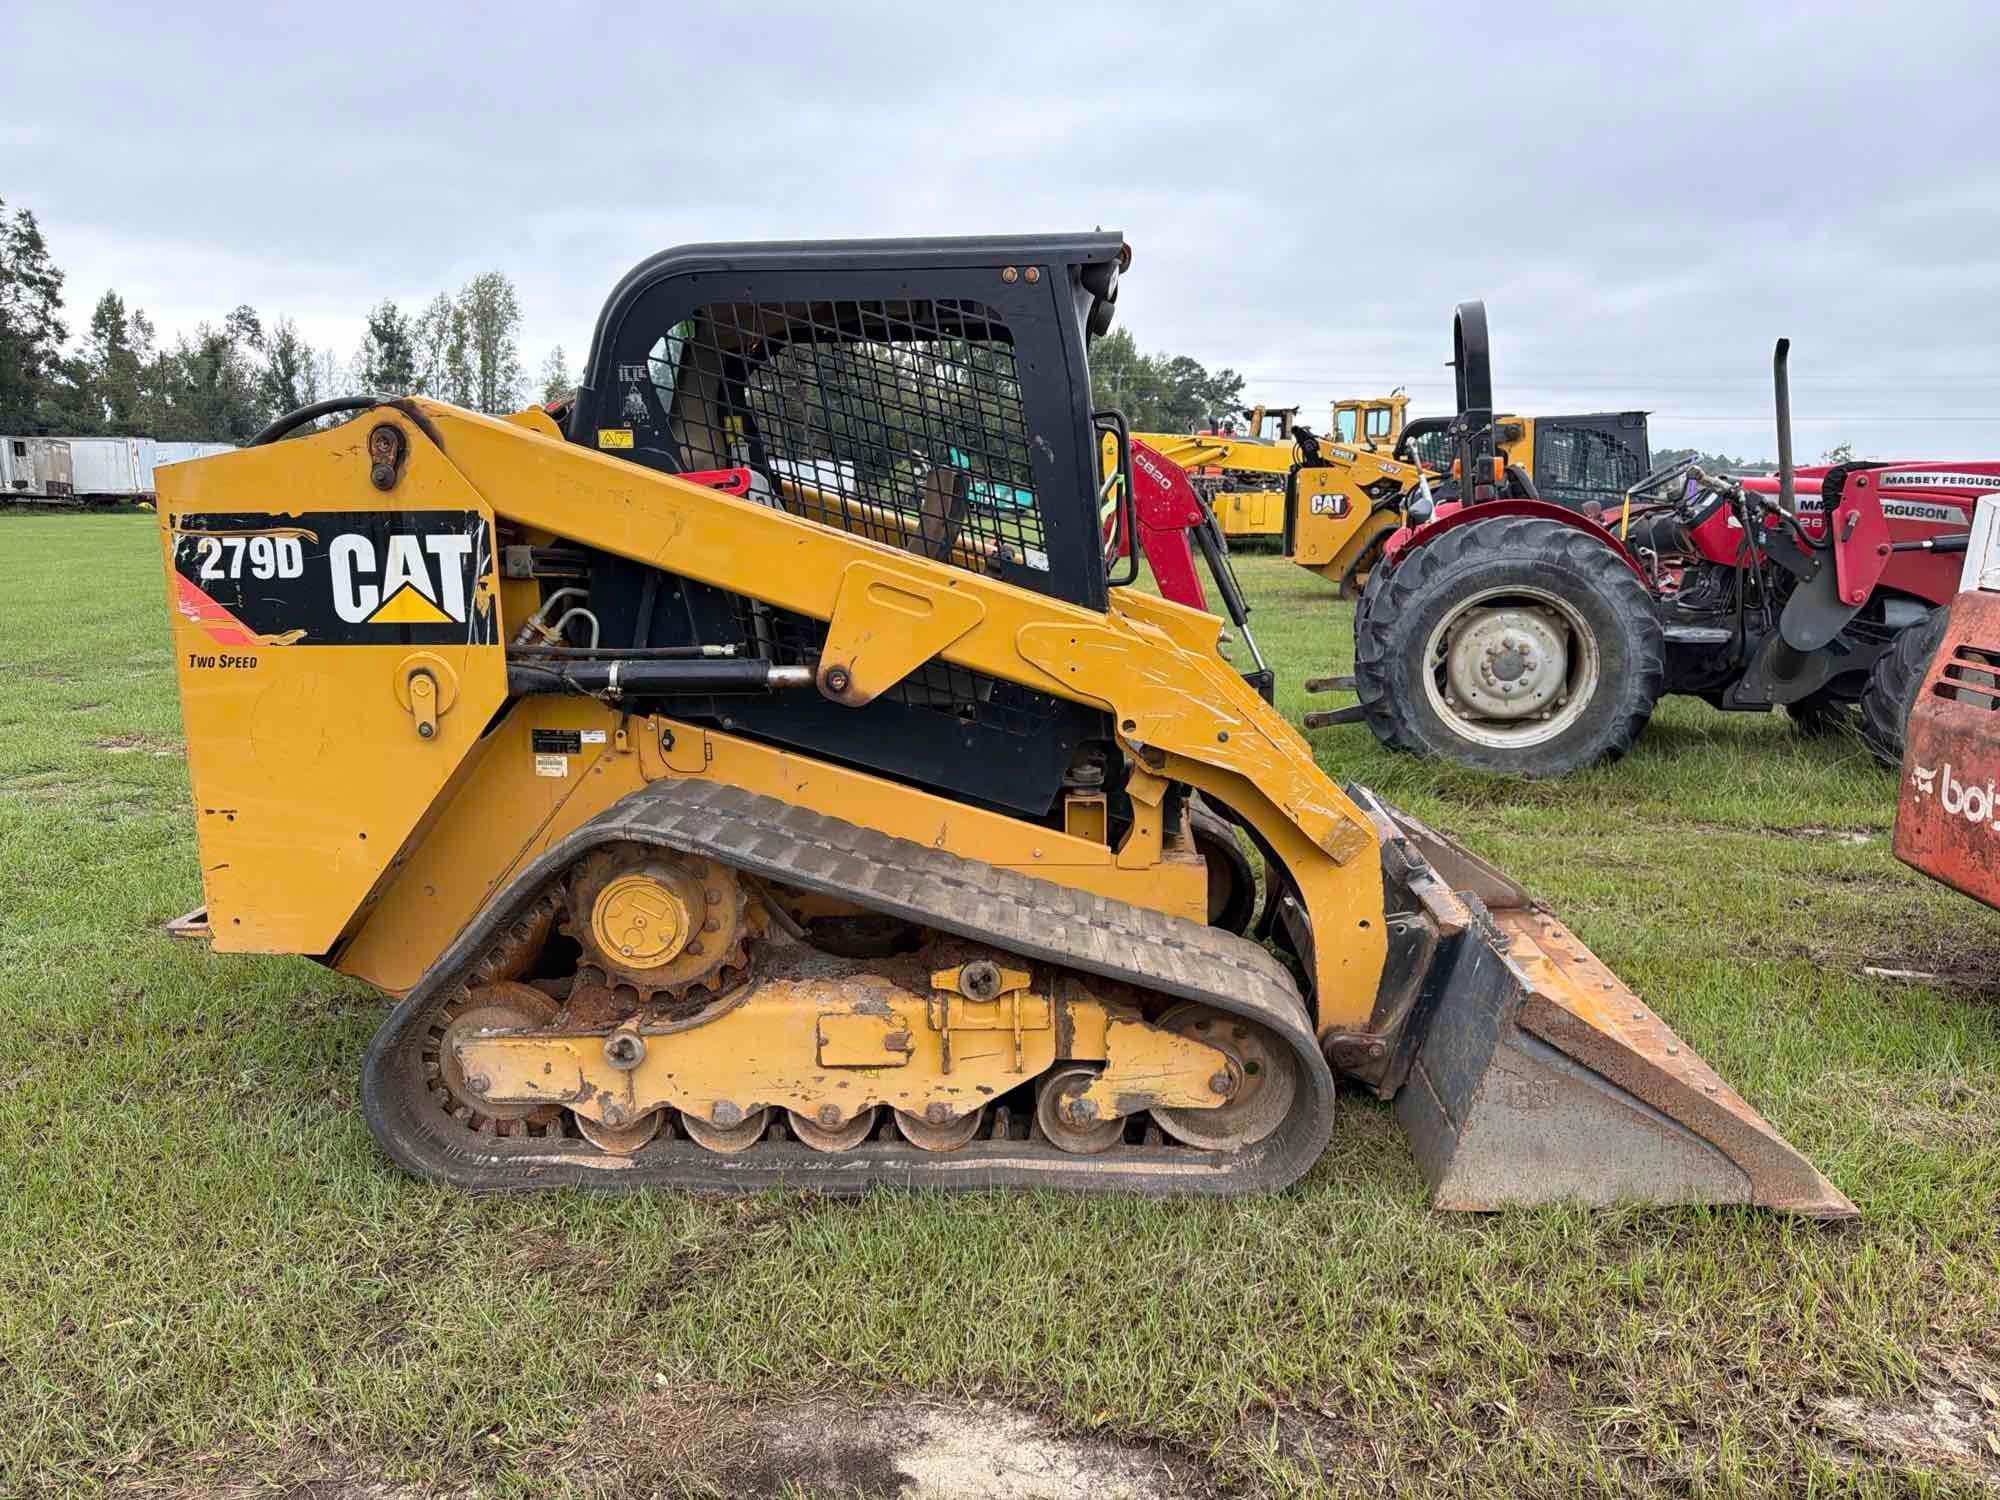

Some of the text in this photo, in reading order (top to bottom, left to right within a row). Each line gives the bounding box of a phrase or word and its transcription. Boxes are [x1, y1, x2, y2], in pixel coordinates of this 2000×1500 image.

[1885, 476, 1939, 485] MASSEY
[1311, 494, 1345, 514] CAT
[1884, 504, 1949, 520] RGUSON
[198, 536, 304, 580] 279D
[329, 533, 472, 624] CAT
